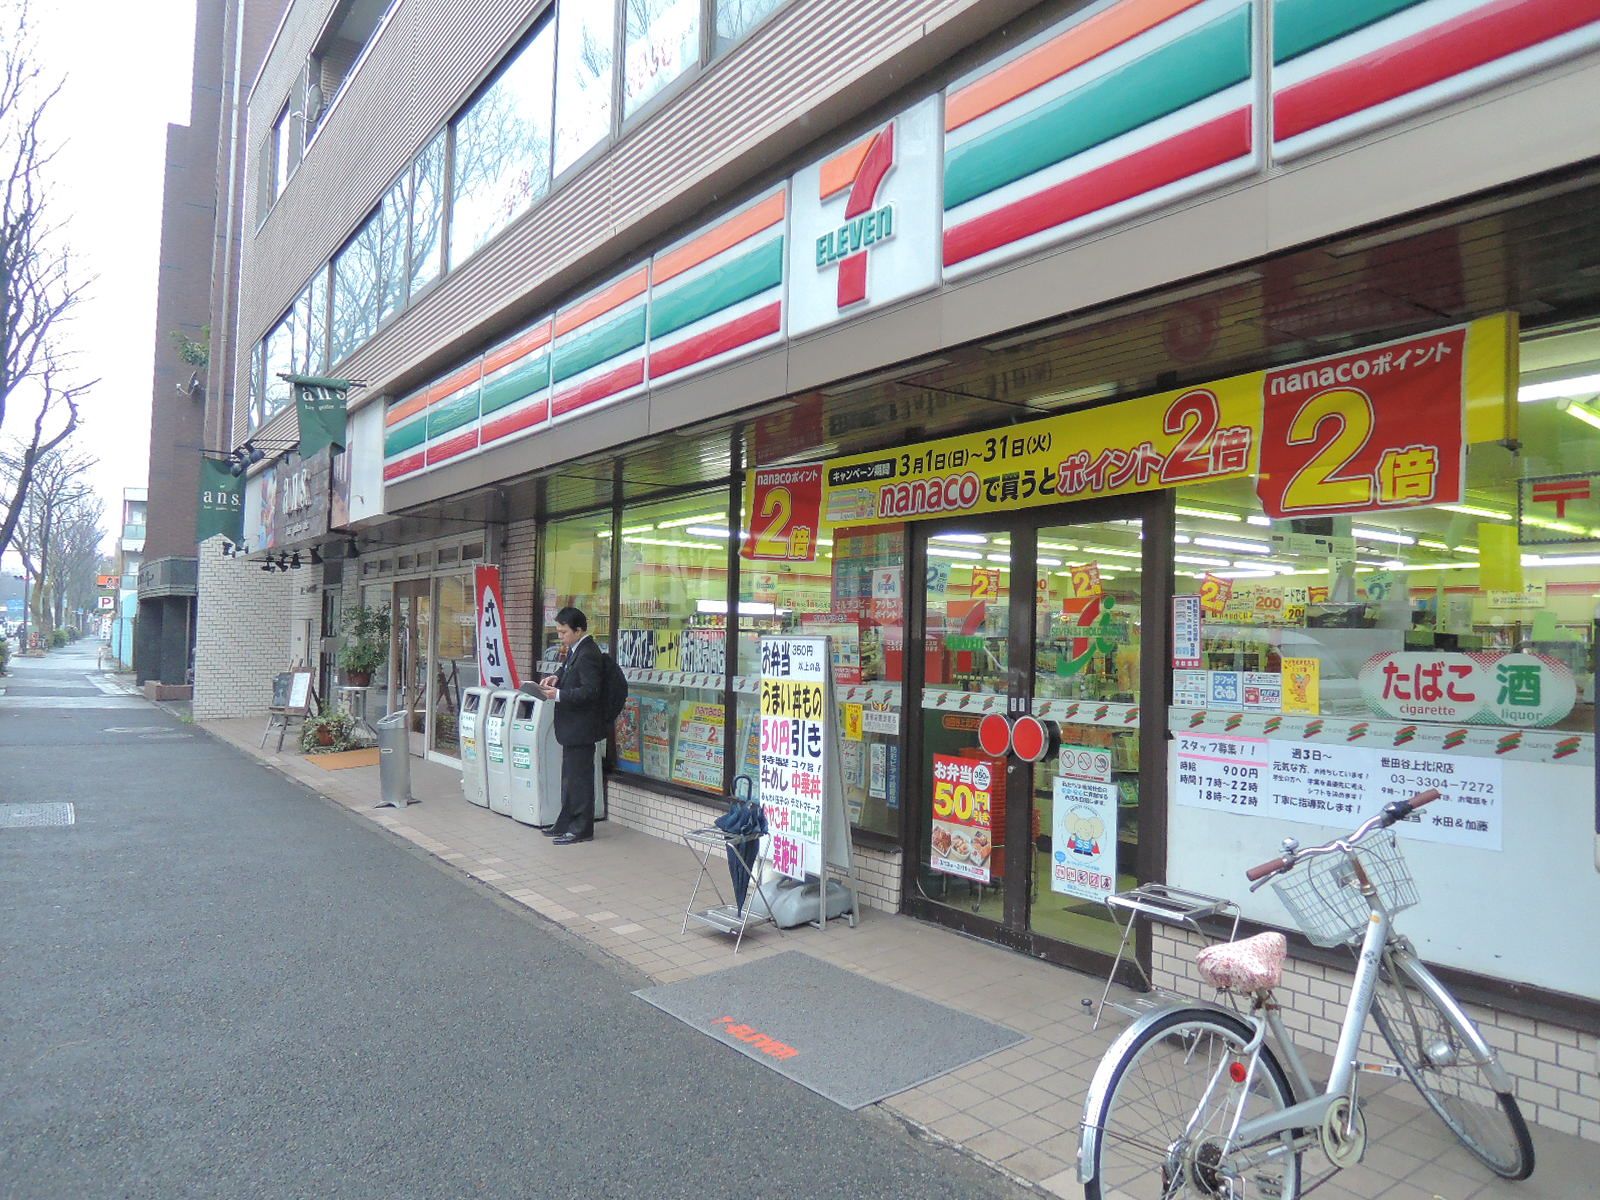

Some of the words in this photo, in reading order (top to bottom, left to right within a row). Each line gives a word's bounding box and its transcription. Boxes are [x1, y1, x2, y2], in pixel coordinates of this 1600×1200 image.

[1270, 342, 1451, 396] nanacoポイント
[1280, 386, 1438, 512] 2倍
[757, 469, 818, 486] nanacoポイント
[754, 485, 811, 559] 2倍
[102, 597, 112, 608] P
[763, 641, 790, 677] お弁当
[792, 645, 814, 656] 350円
[798, 662, 821, 672] 以上の品
[1382, 660, 1475, 702] たばこ
[1496, 663, 1541, 706] 酒
[763, 681, 822, 718] うまい丼もの
[1400, 704, 1456, 716] cigarette
[1501, 709, 1543, 721] liquor
[762, 720, 822, 758] 50円引き
[761, 765, 788, 792] 牛めし
[792, 770, 821, 800] 中華丼
[934, 761, 972, 784] お弁当
[1180, 761, 1196, 772] 時給
[1223, 765, 1258, 779] 900円
[1381, 757, 1455, 774] 世田谷上北沢店
